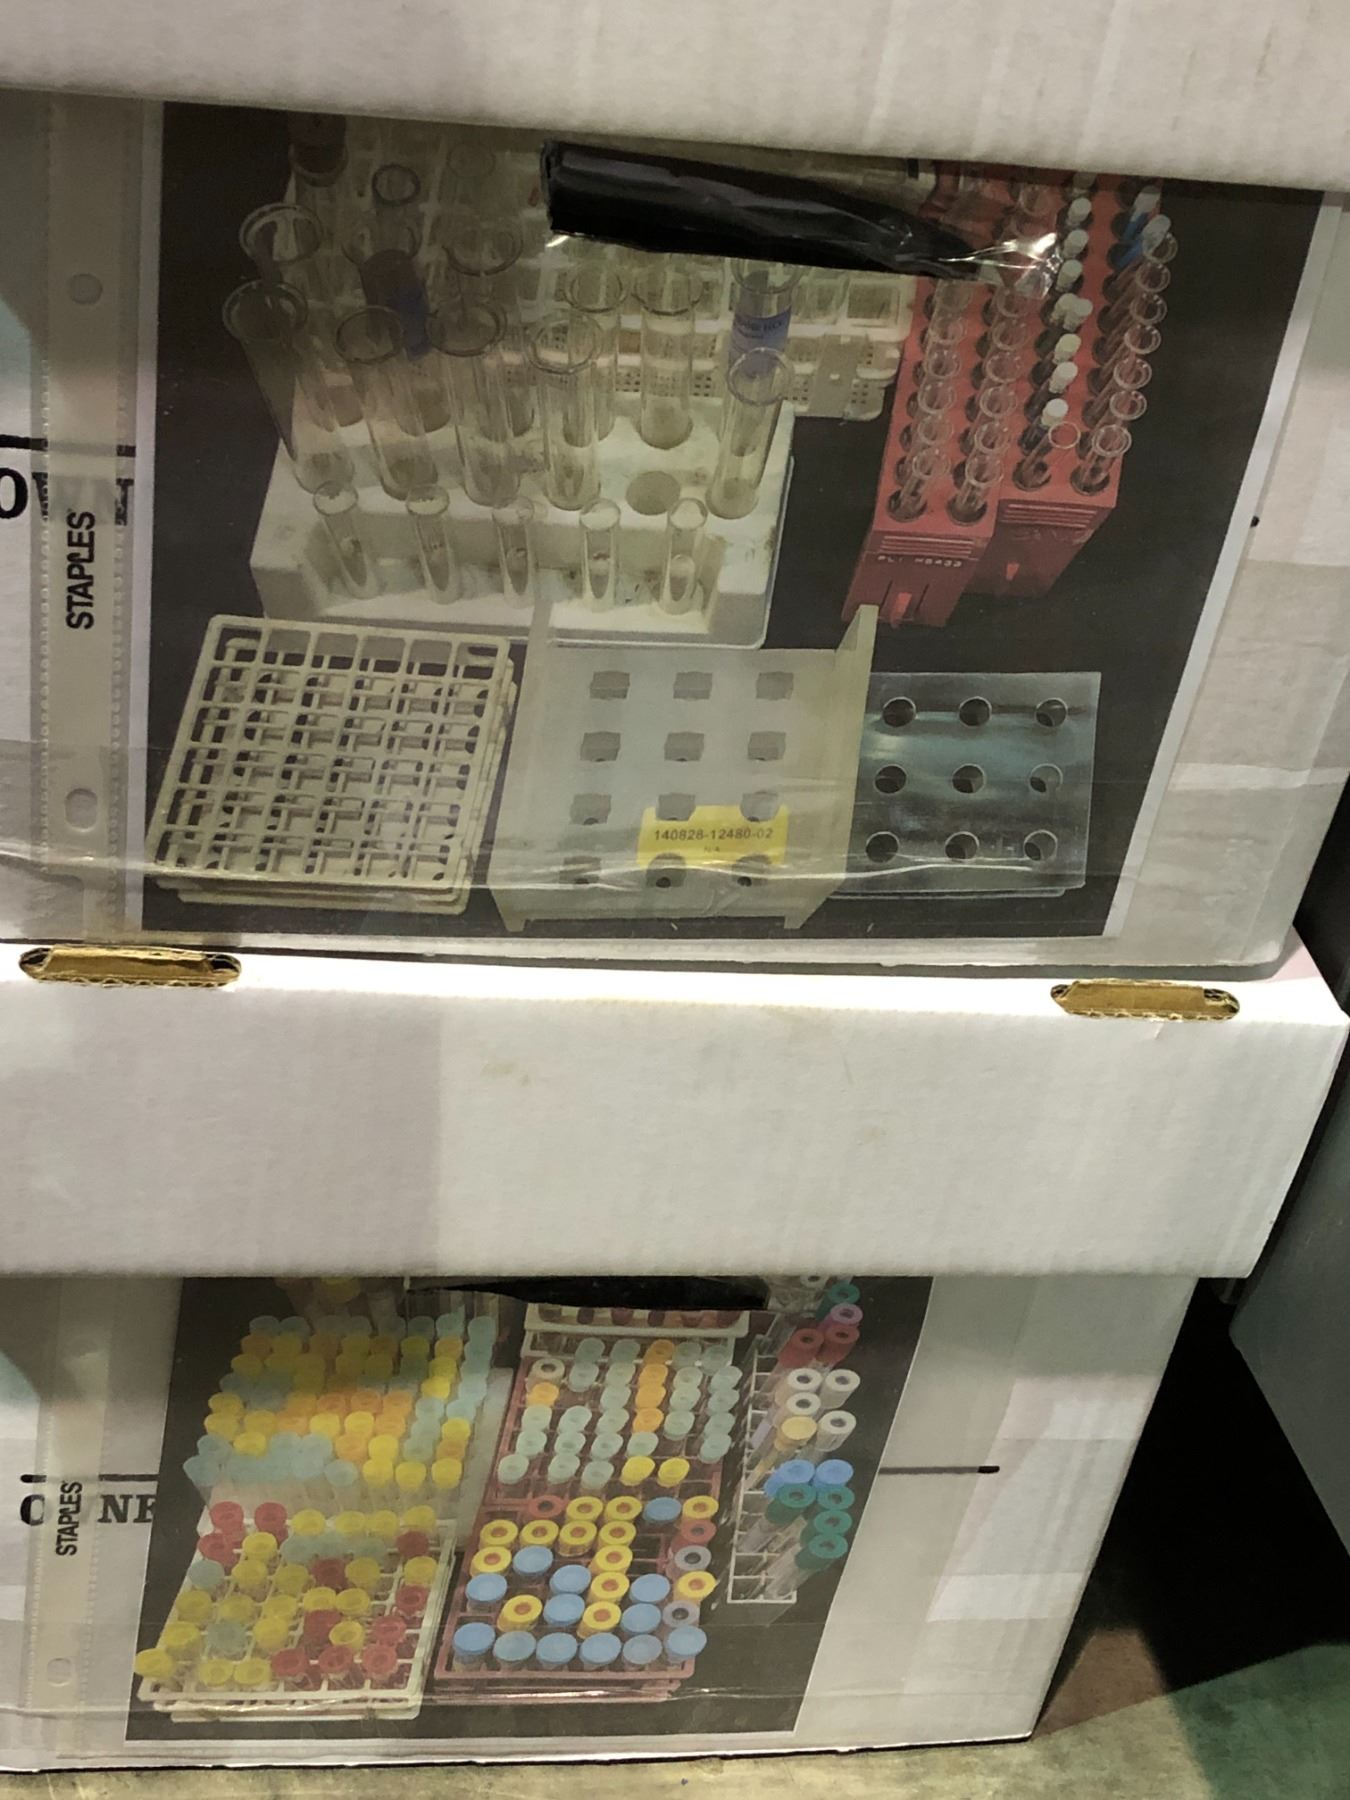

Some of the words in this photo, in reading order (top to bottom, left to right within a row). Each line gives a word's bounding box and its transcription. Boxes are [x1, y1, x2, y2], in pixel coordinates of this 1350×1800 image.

[66, 511, 95, 629] STAPLES
[654, 828, 773, 841] 140828-12480-02
[56, 1481, 83, 1556] STAPLES
